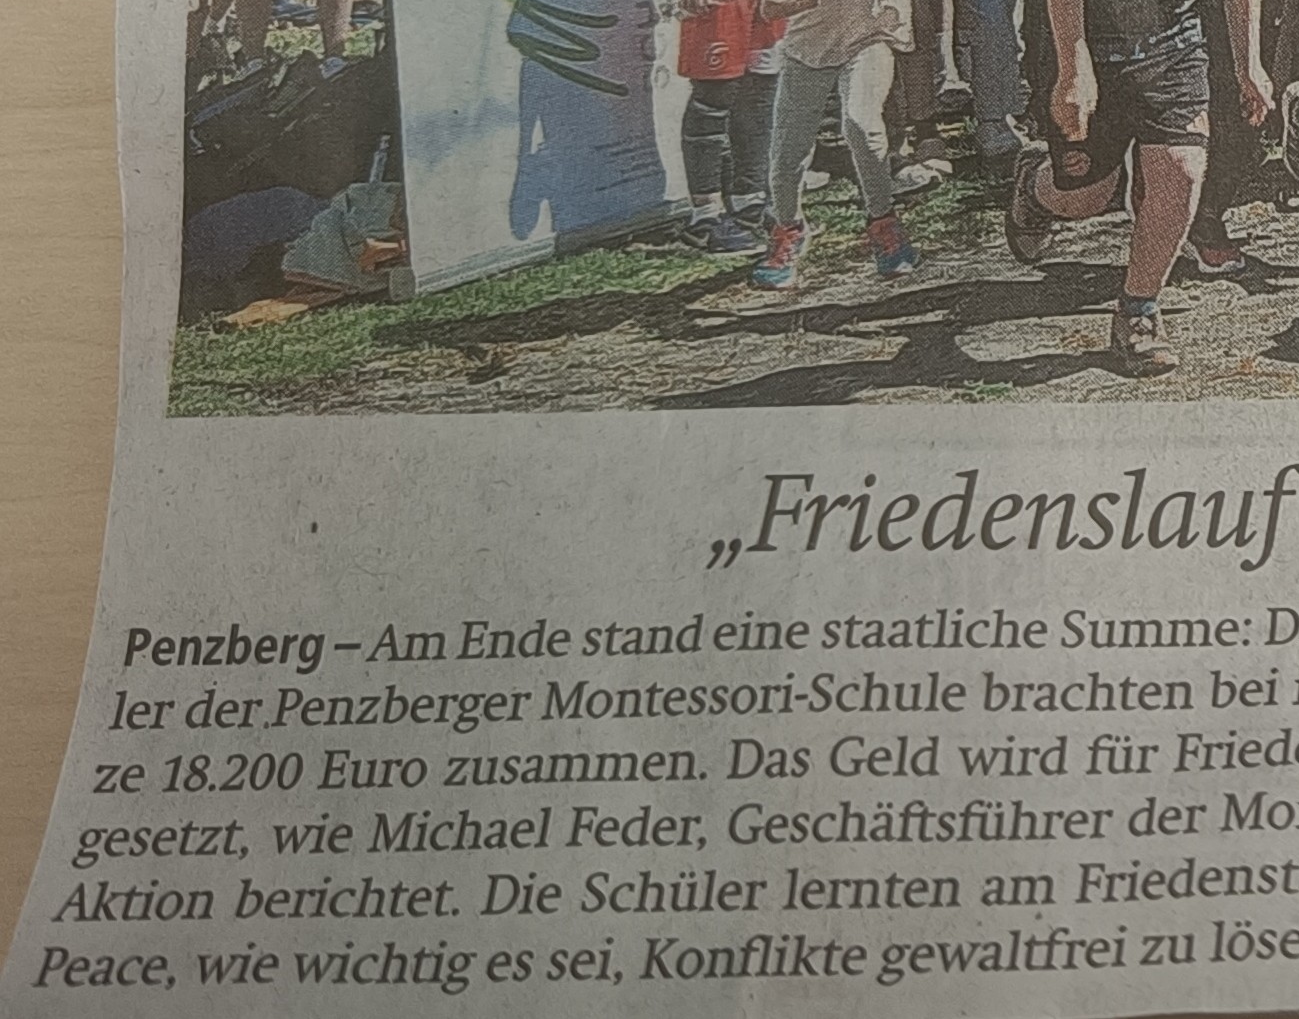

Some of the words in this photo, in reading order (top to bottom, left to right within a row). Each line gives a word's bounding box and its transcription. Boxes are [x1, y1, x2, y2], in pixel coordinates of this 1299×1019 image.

[124, 623, 325, 675] Penzberg
[365, 624, 448, 663] Am
[456, 619, 571, 660] Ende
[582, 614, 703, 656] stand
[713, 611, 809, 651] eine
[822, 609, 1047, 649] staatliche
[1061, 610, 1252, 648] Summe:
[109, 691, 175, 730] ler
[185, 689, 263, 729] der
[271, 685, 531, 734] Penzberger
[541, 672, 966, 720] Montessori-Schule
[983, 672, 1193, 711] brachten
[1210, 668, 1277, 708] bei
[93, 765, 145, 793] ze
[162, 752, 303, 792] 18.200
[317, 750, 427, 789] Euro
[443, 751, 708, 786] zusammen.
[727, 739, 810, 779] Das
[830, 736, 939, 777] Geld
[959, 736, 1067, 776] wird
[1086, 734, 1159, 775] für
[72, 820, 248, 869] gesetzt,
[273, 813, 353, 854] wie
[367, 807, 551, 853] Michael
[566, 806, 706, 850] Feder,
[728, 800, 1113, 845] Geschäftsführer
[1128, 797, 1207, 837] der
[52, 880, 213, 922] Aktion
[235, 876, 460, 919] berichtet.
[481, 872, 561, 915] Die
[581, 870, 767, 913] Schüler
[783, 868, 960, 910] lernten
[981, 875, 1055, 906] am
[33, 947, 175, 990] Peace,
[198, 942, 279, 984] wie
[295, 941, 477, 995] wichtig
[486, 950, 534, 982] es
[546, 937, 622, 985] sei,
[639, 934, 866, 979] Konflikte
[876, 925, 1125, 986] gewaltfrei
[1140, 934, 1195, 965] zu
